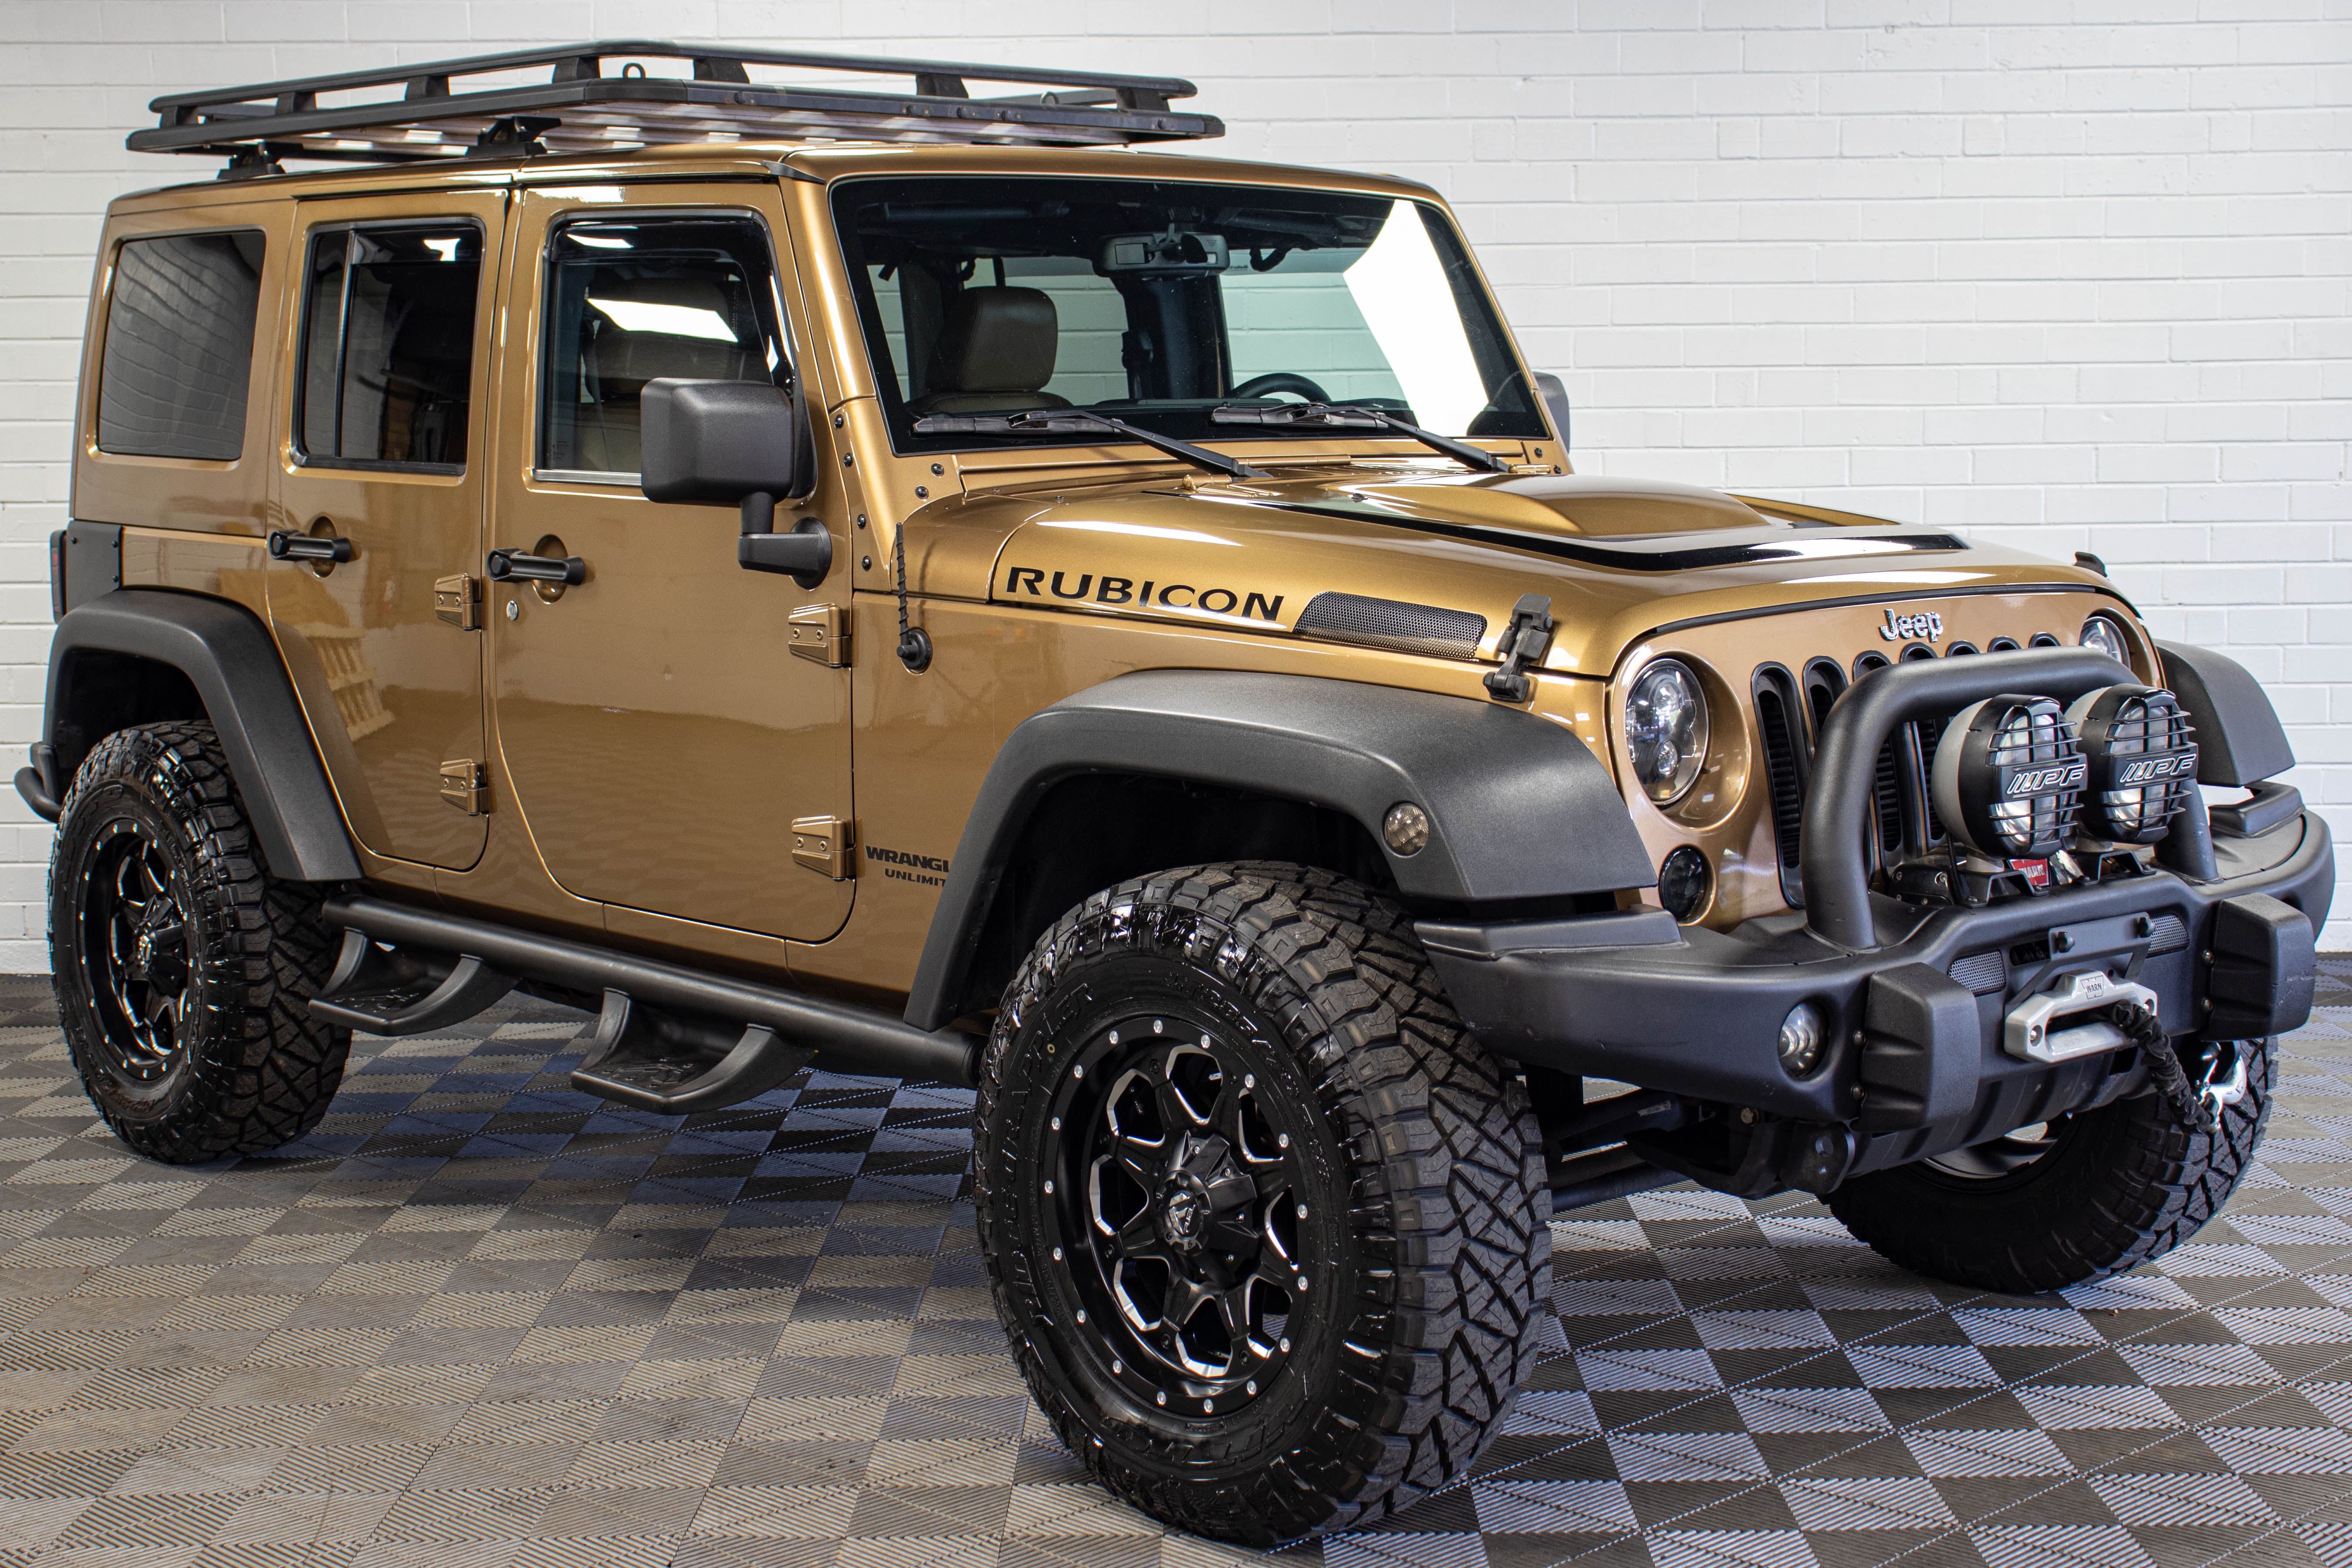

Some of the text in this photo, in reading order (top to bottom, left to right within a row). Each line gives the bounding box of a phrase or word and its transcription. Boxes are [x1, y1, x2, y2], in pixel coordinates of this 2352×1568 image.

[1006, 566, 1284, 622] RUBICON
[1879, 608, 1943, 642] Jeep
[865, 846, 950, 873] WRANGL
[885, 868, 946, 887] UNLIMIT
[2085, 983, 2102, 993] WARN
